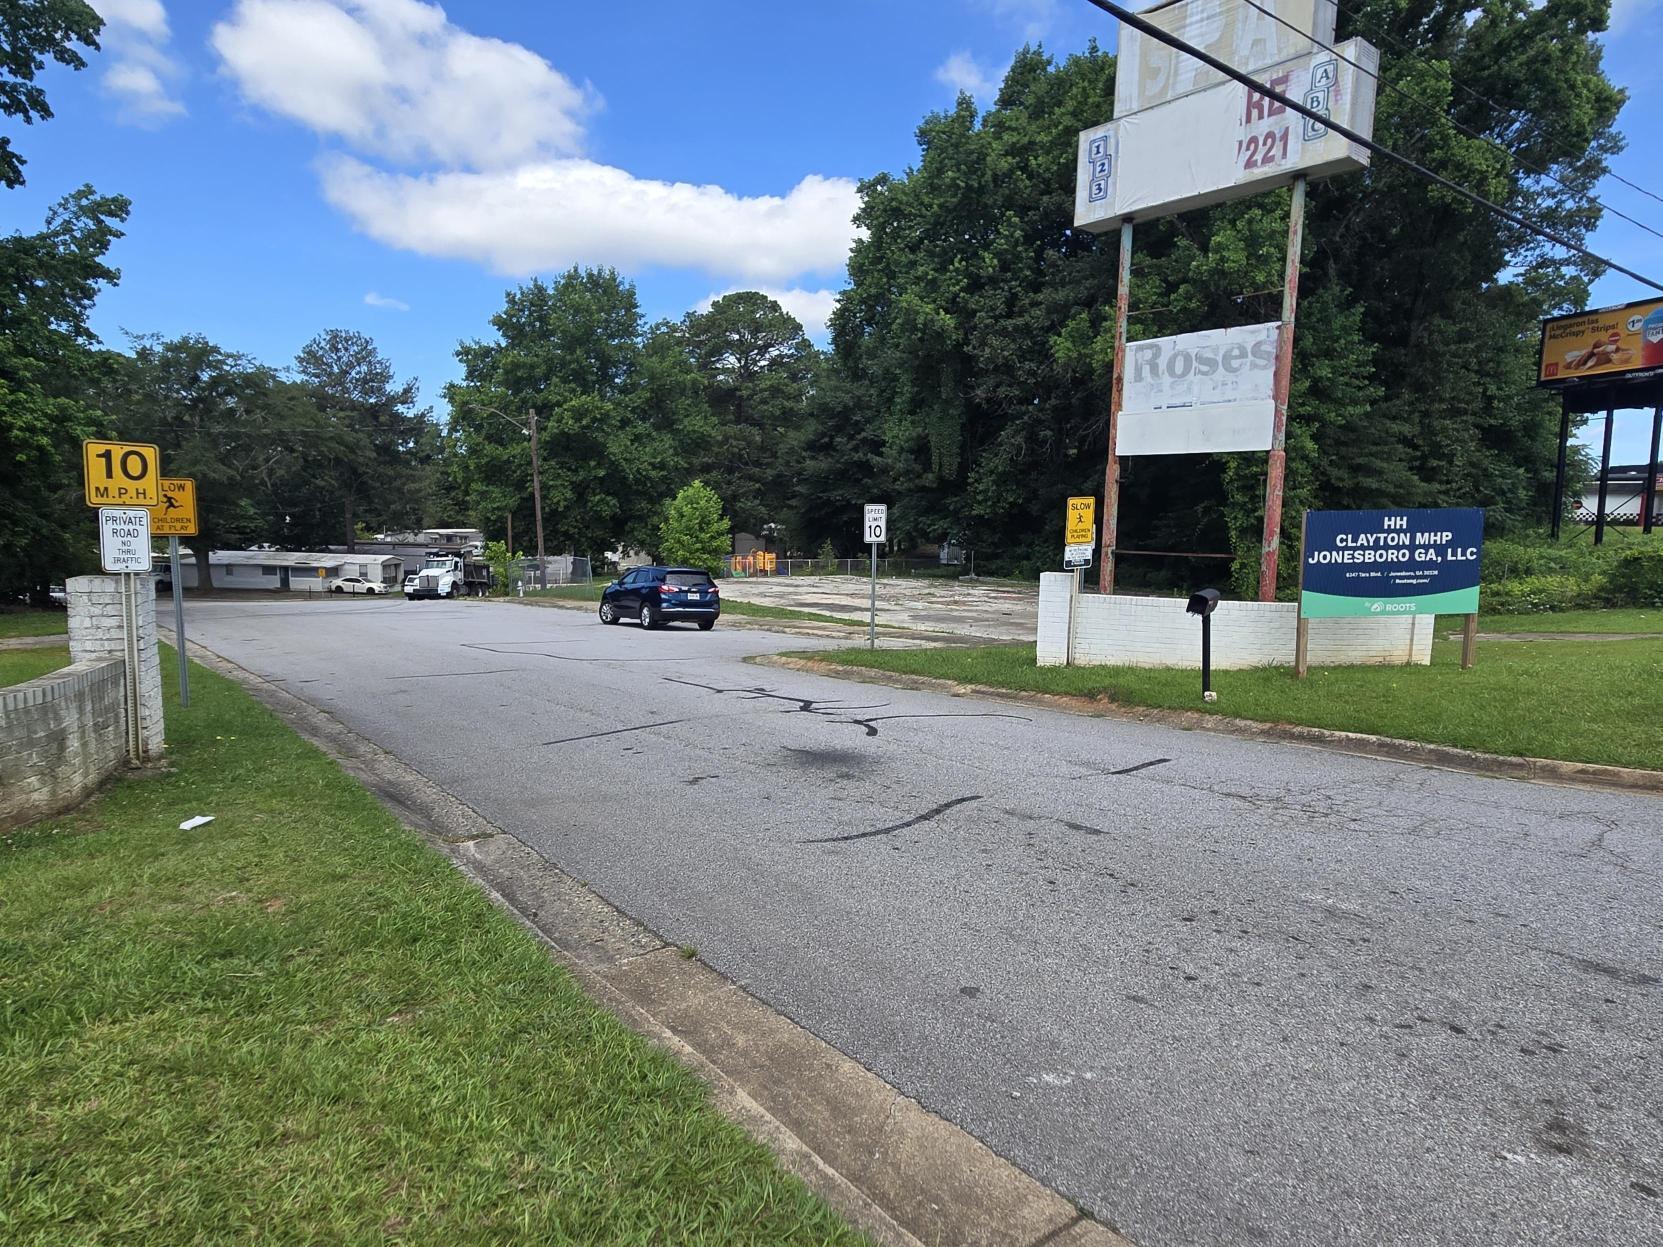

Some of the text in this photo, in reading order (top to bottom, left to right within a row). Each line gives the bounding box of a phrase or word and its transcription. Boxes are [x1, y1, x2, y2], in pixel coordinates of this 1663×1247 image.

[1317, 68, 1331, 83] A
[1246, 75, 1289, 125] RE
[1310, 95, 1321, 109] B
[1098, 162, 1106, 174] 2
[1094, 183, 1103, 195] 3
[1591, 322, 1619, 334] Strips!
[1133, 339, 1277, 383] Roses
[95, 449, 149, 481] 10
[95, 486, 153, 500] M.P.H.
[161, 482, 186, 493] LOW
[1071, 502, 1092, 511] SLOW
[104, 515, 145, 527] PRIVATE
[152, 516, 192, 524] CHILDREN
[1383, 516, 1408, 530] HH
[112, 528, 139, 538] ROAD
[155, 524, 165, 532] AT
[868, 524, 882, 538] 10
[1336, 531, 1453, 547] CLAYTON MHP
[117, 548, 137, 556] THRU
[1308, 547, 1478, 564] JONESBORO GA, LLC
[1386, 603, 1416, 611] ROOTS
